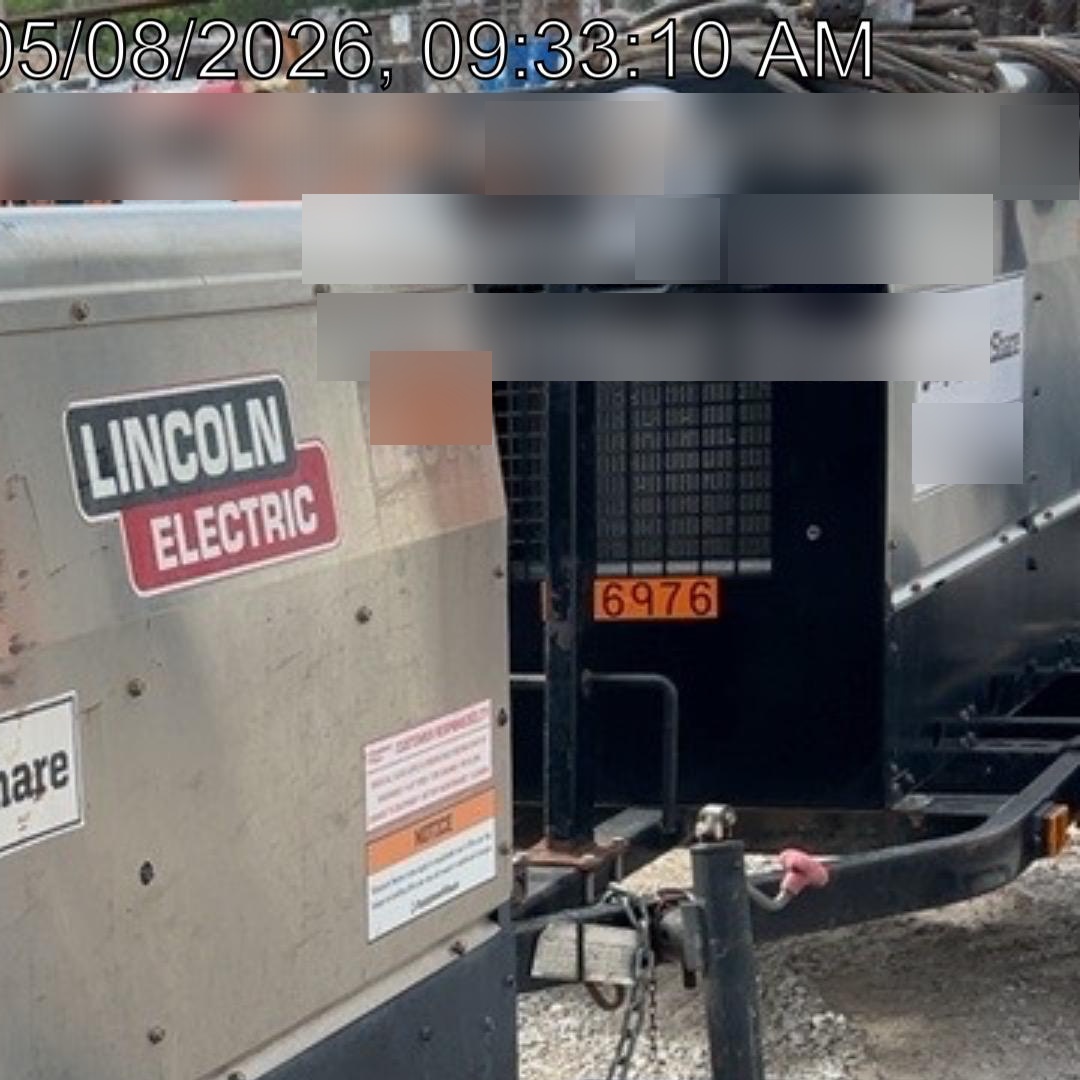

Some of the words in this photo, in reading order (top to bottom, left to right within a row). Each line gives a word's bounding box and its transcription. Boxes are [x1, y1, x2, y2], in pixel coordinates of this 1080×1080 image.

[80, 395, 286, 499] LINCOLN
[149, 484, 318, 571] ELECTRIC
[602, 581, 712, 616] 6976
